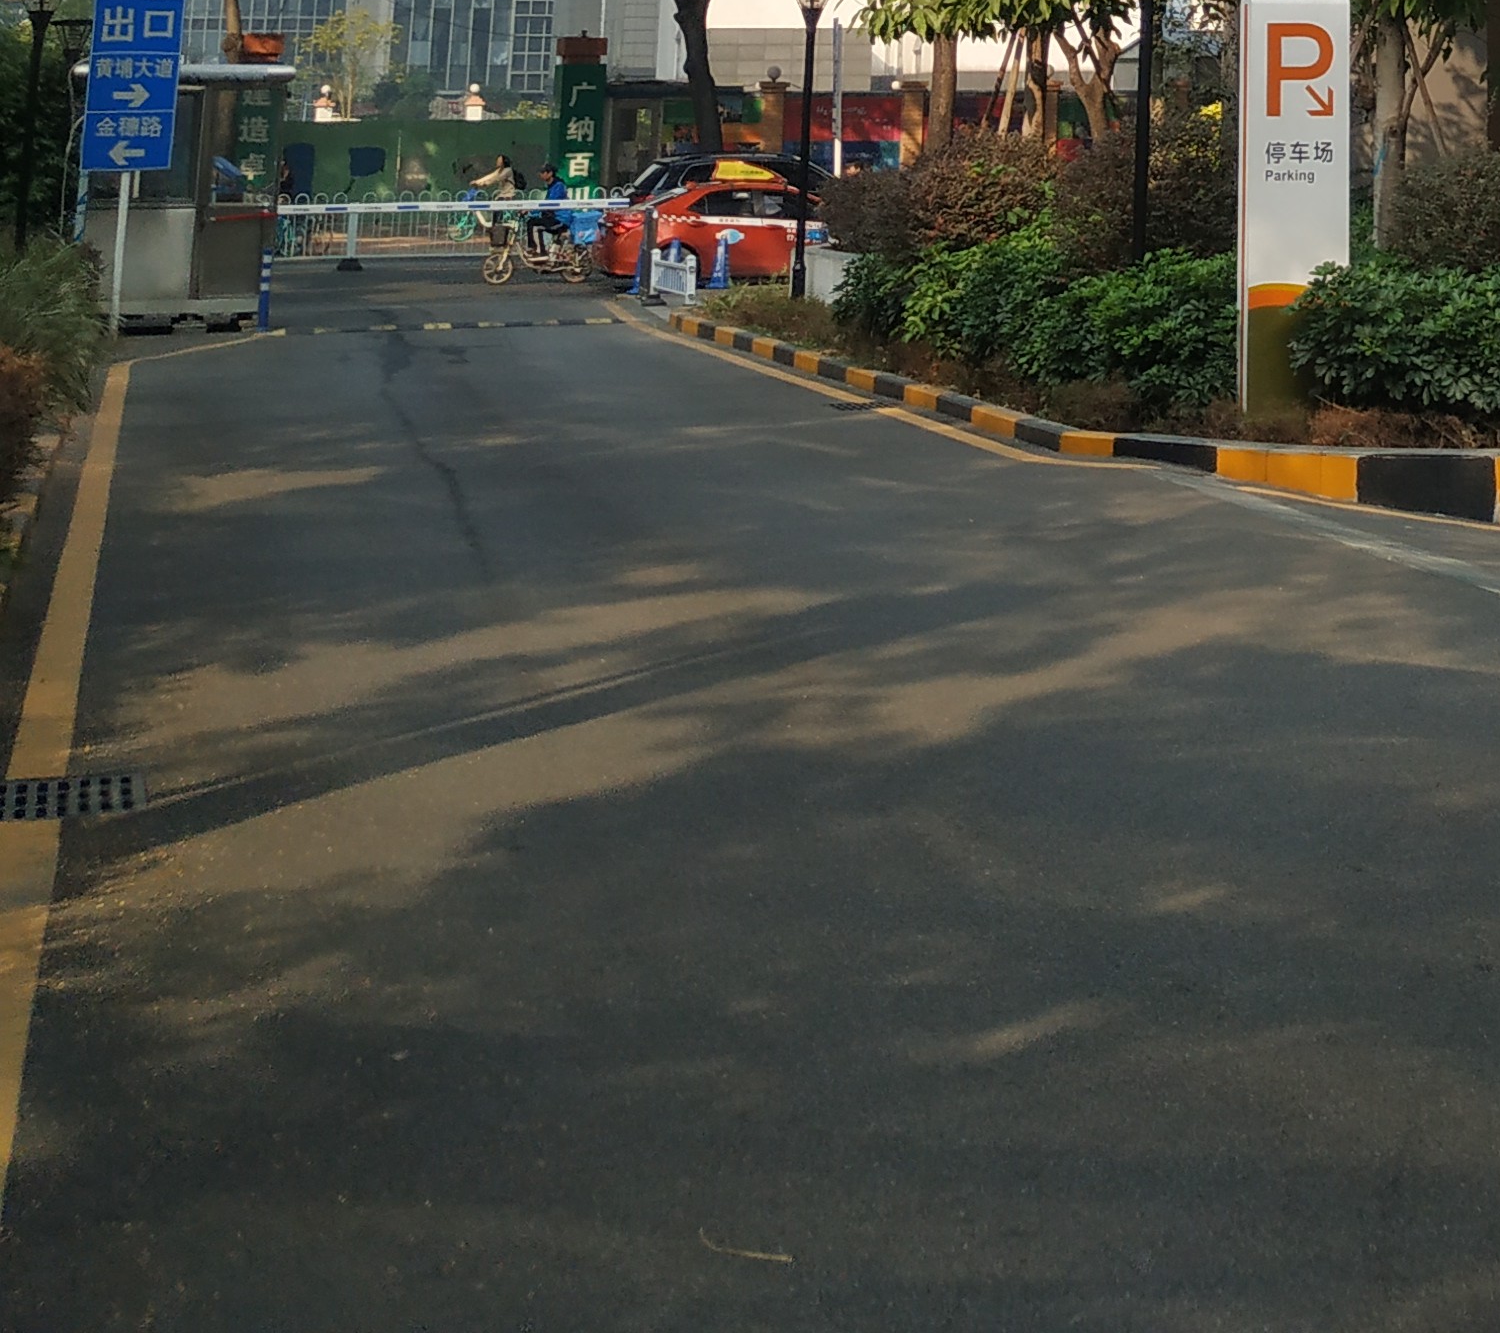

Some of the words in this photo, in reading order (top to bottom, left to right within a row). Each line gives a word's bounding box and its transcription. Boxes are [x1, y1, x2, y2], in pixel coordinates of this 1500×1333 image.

[101, 5, 175, 43] 出口
[95, 57, 174, 79] 黄埔大道
[1266, 22, 1334, 117] P
[95, 116, 162, 138] 金穗路
[1265, 141, 1333, 164] 停车场
[1265, 169, 1315, 184] Parking
